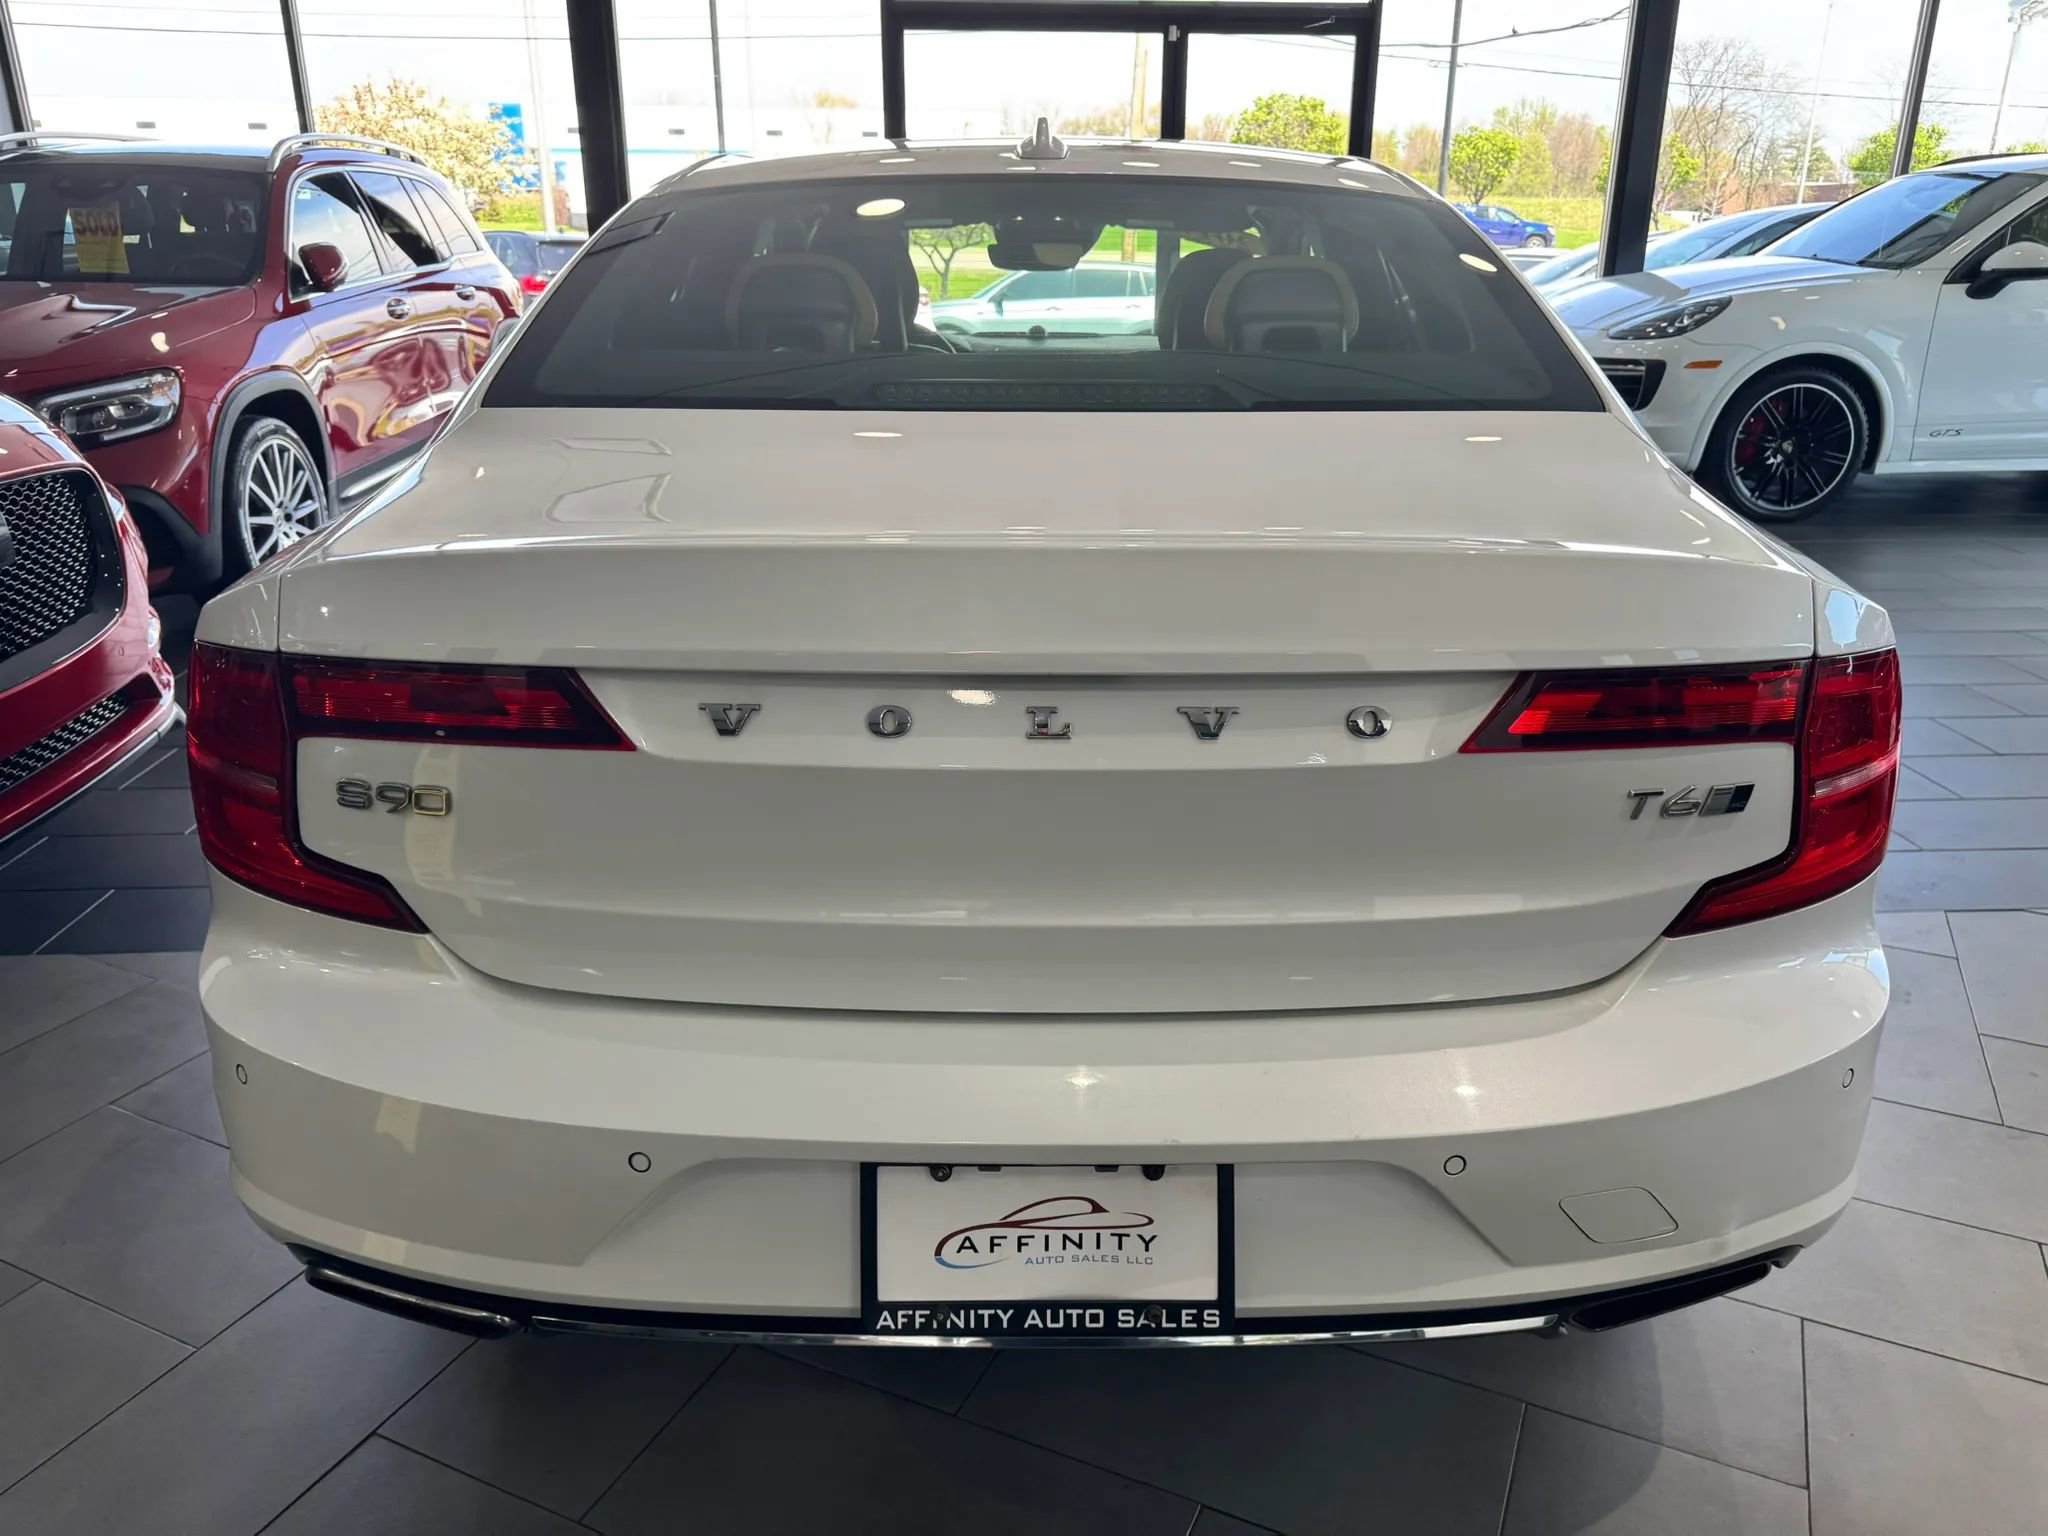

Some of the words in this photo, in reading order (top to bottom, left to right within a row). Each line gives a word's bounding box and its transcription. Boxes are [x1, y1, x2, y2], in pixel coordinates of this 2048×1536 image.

[74, 209, 118, 237] SOLD
[1929, 428, 1964, 438] GTS
[698, 702, 1393, 740] VOLVO
[336, 777, 452, 817] S90
[1627, 785, 1702, 820] T6
[956, 1232, 1158, 1254] AFFINITY
[1024, 1255, 1064, 1266] AUTO
[1071, 1254, 1120, 1264] SALES
[1126, 1256, 1153, 1266] LLC
[1023, 1309, 1105, 1329] AUTO
[1117, 1309, 1221, 1329] SALES
